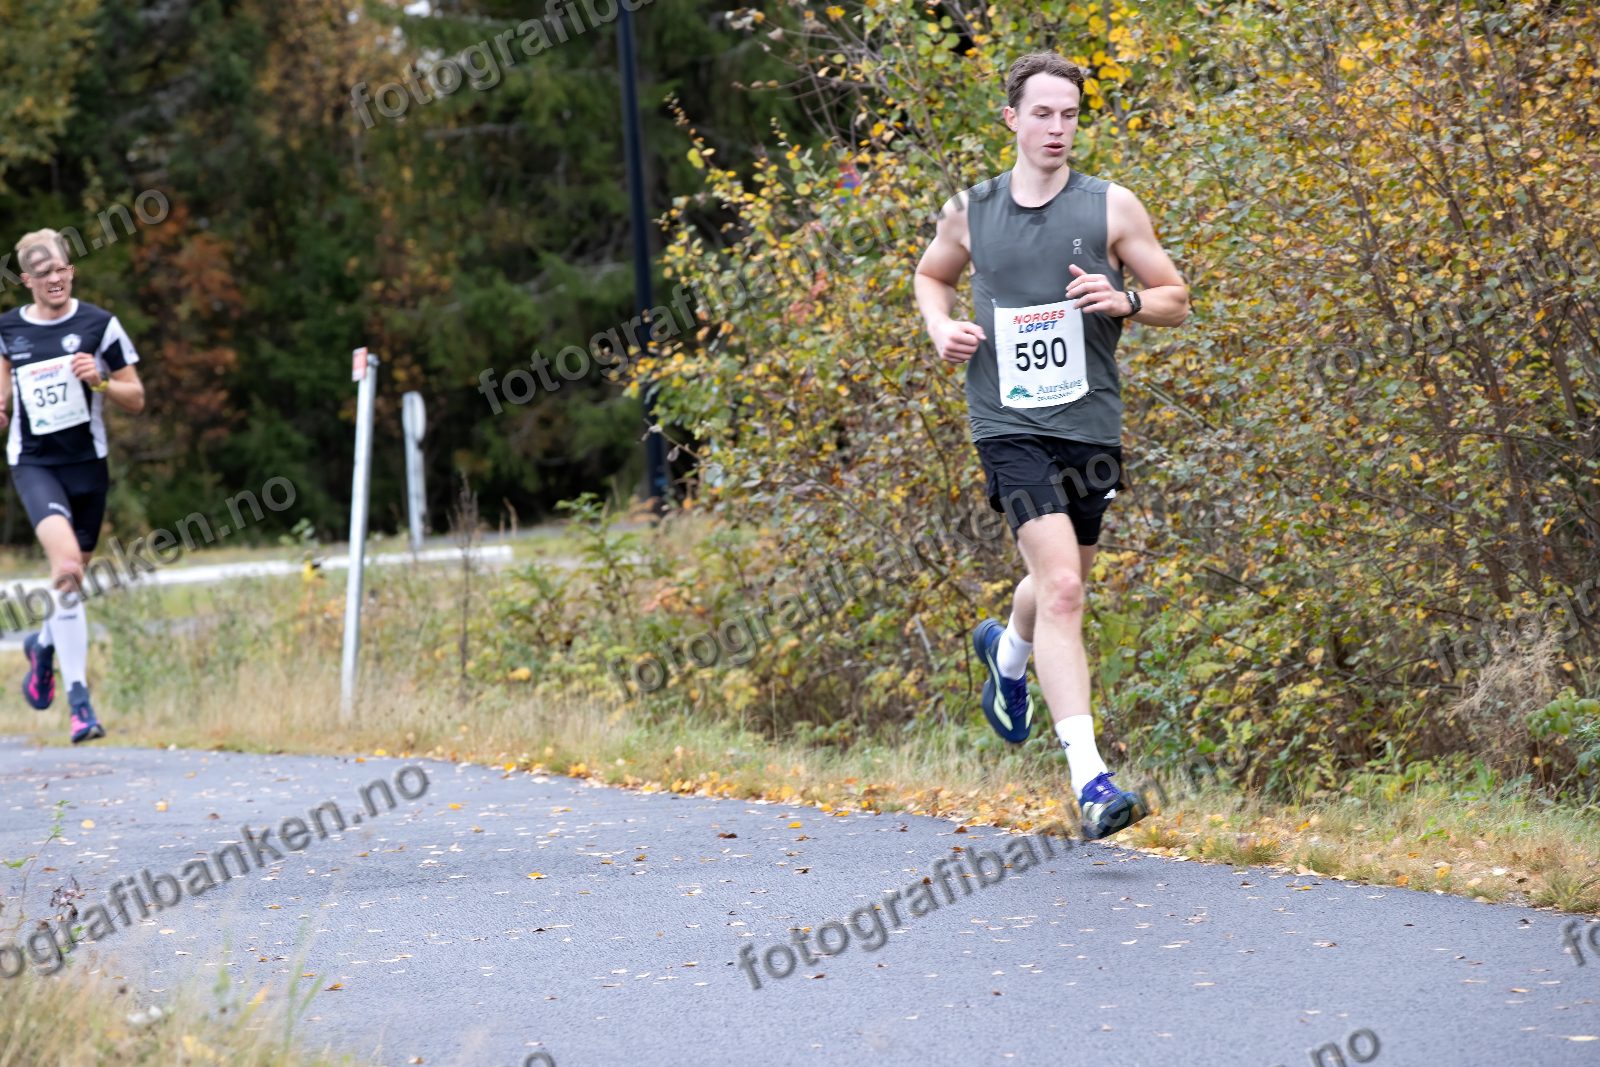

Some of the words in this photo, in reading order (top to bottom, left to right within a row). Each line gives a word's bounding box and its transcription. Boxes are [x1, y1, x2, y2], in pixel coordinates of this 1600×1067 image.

[1013, 309, 1066, 325] NORGES
[1018, 319, 1059, 334] LØPET
[1015, 336, 1068, 372] 590
[33, 381, 69, 408] 357
